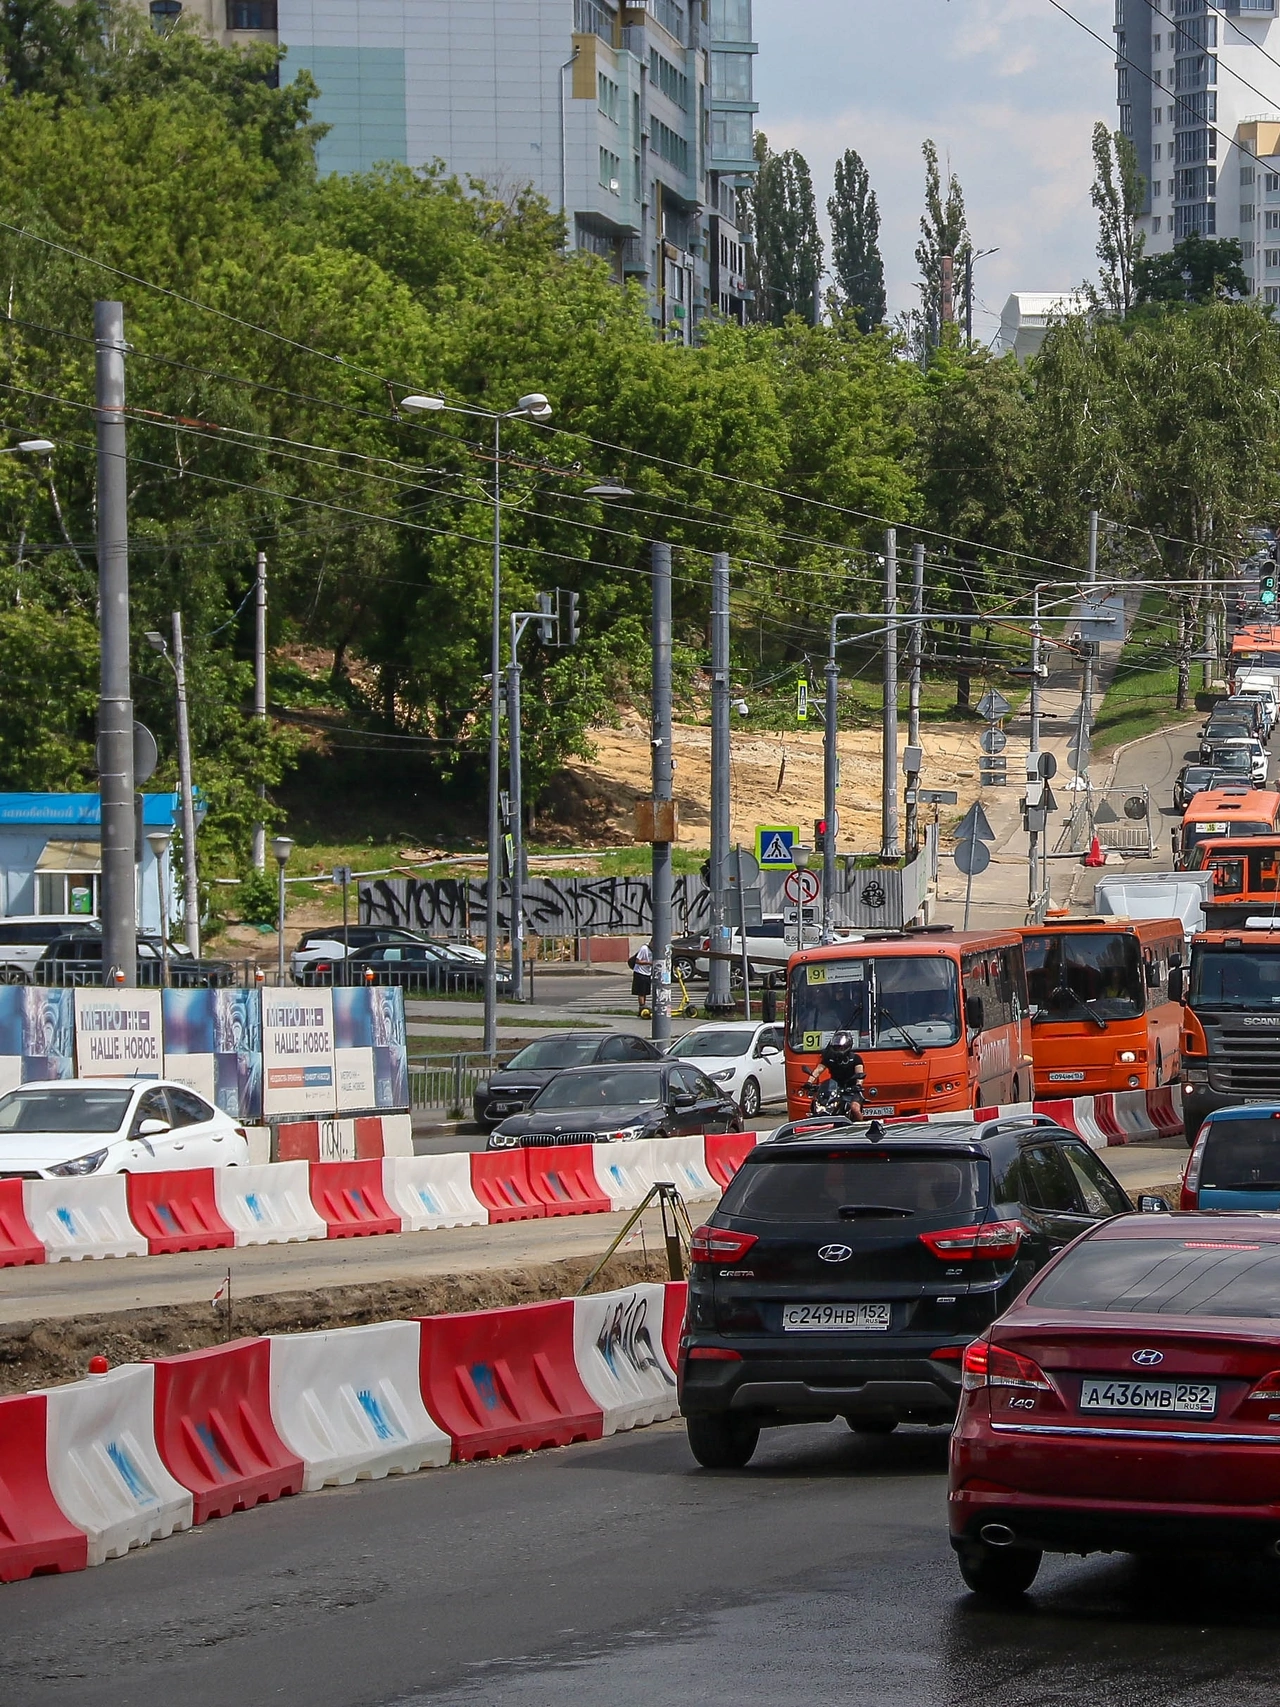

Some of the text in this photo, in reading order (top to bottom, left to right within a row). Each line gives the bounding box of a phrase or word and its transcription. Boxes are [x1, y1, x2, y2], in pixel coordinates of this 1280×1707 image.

[81, 1008, 121, 1031] МЕТРО
[267, 1005, 301, 1027] МЕТРО
[90, 1036, 159, 1060] НАШЕ. НОВОЕ.
[274, 1031, 332, 1054] НАШЕ. НОВОЕ.
[805, 1035, 821, 1048] 91
[788, 1304, 885, 1324] С249НВ 152
[1009, 1397, 1035, 1409] i40
[1087, 1384, 1210, 1408] А436МВ 252
